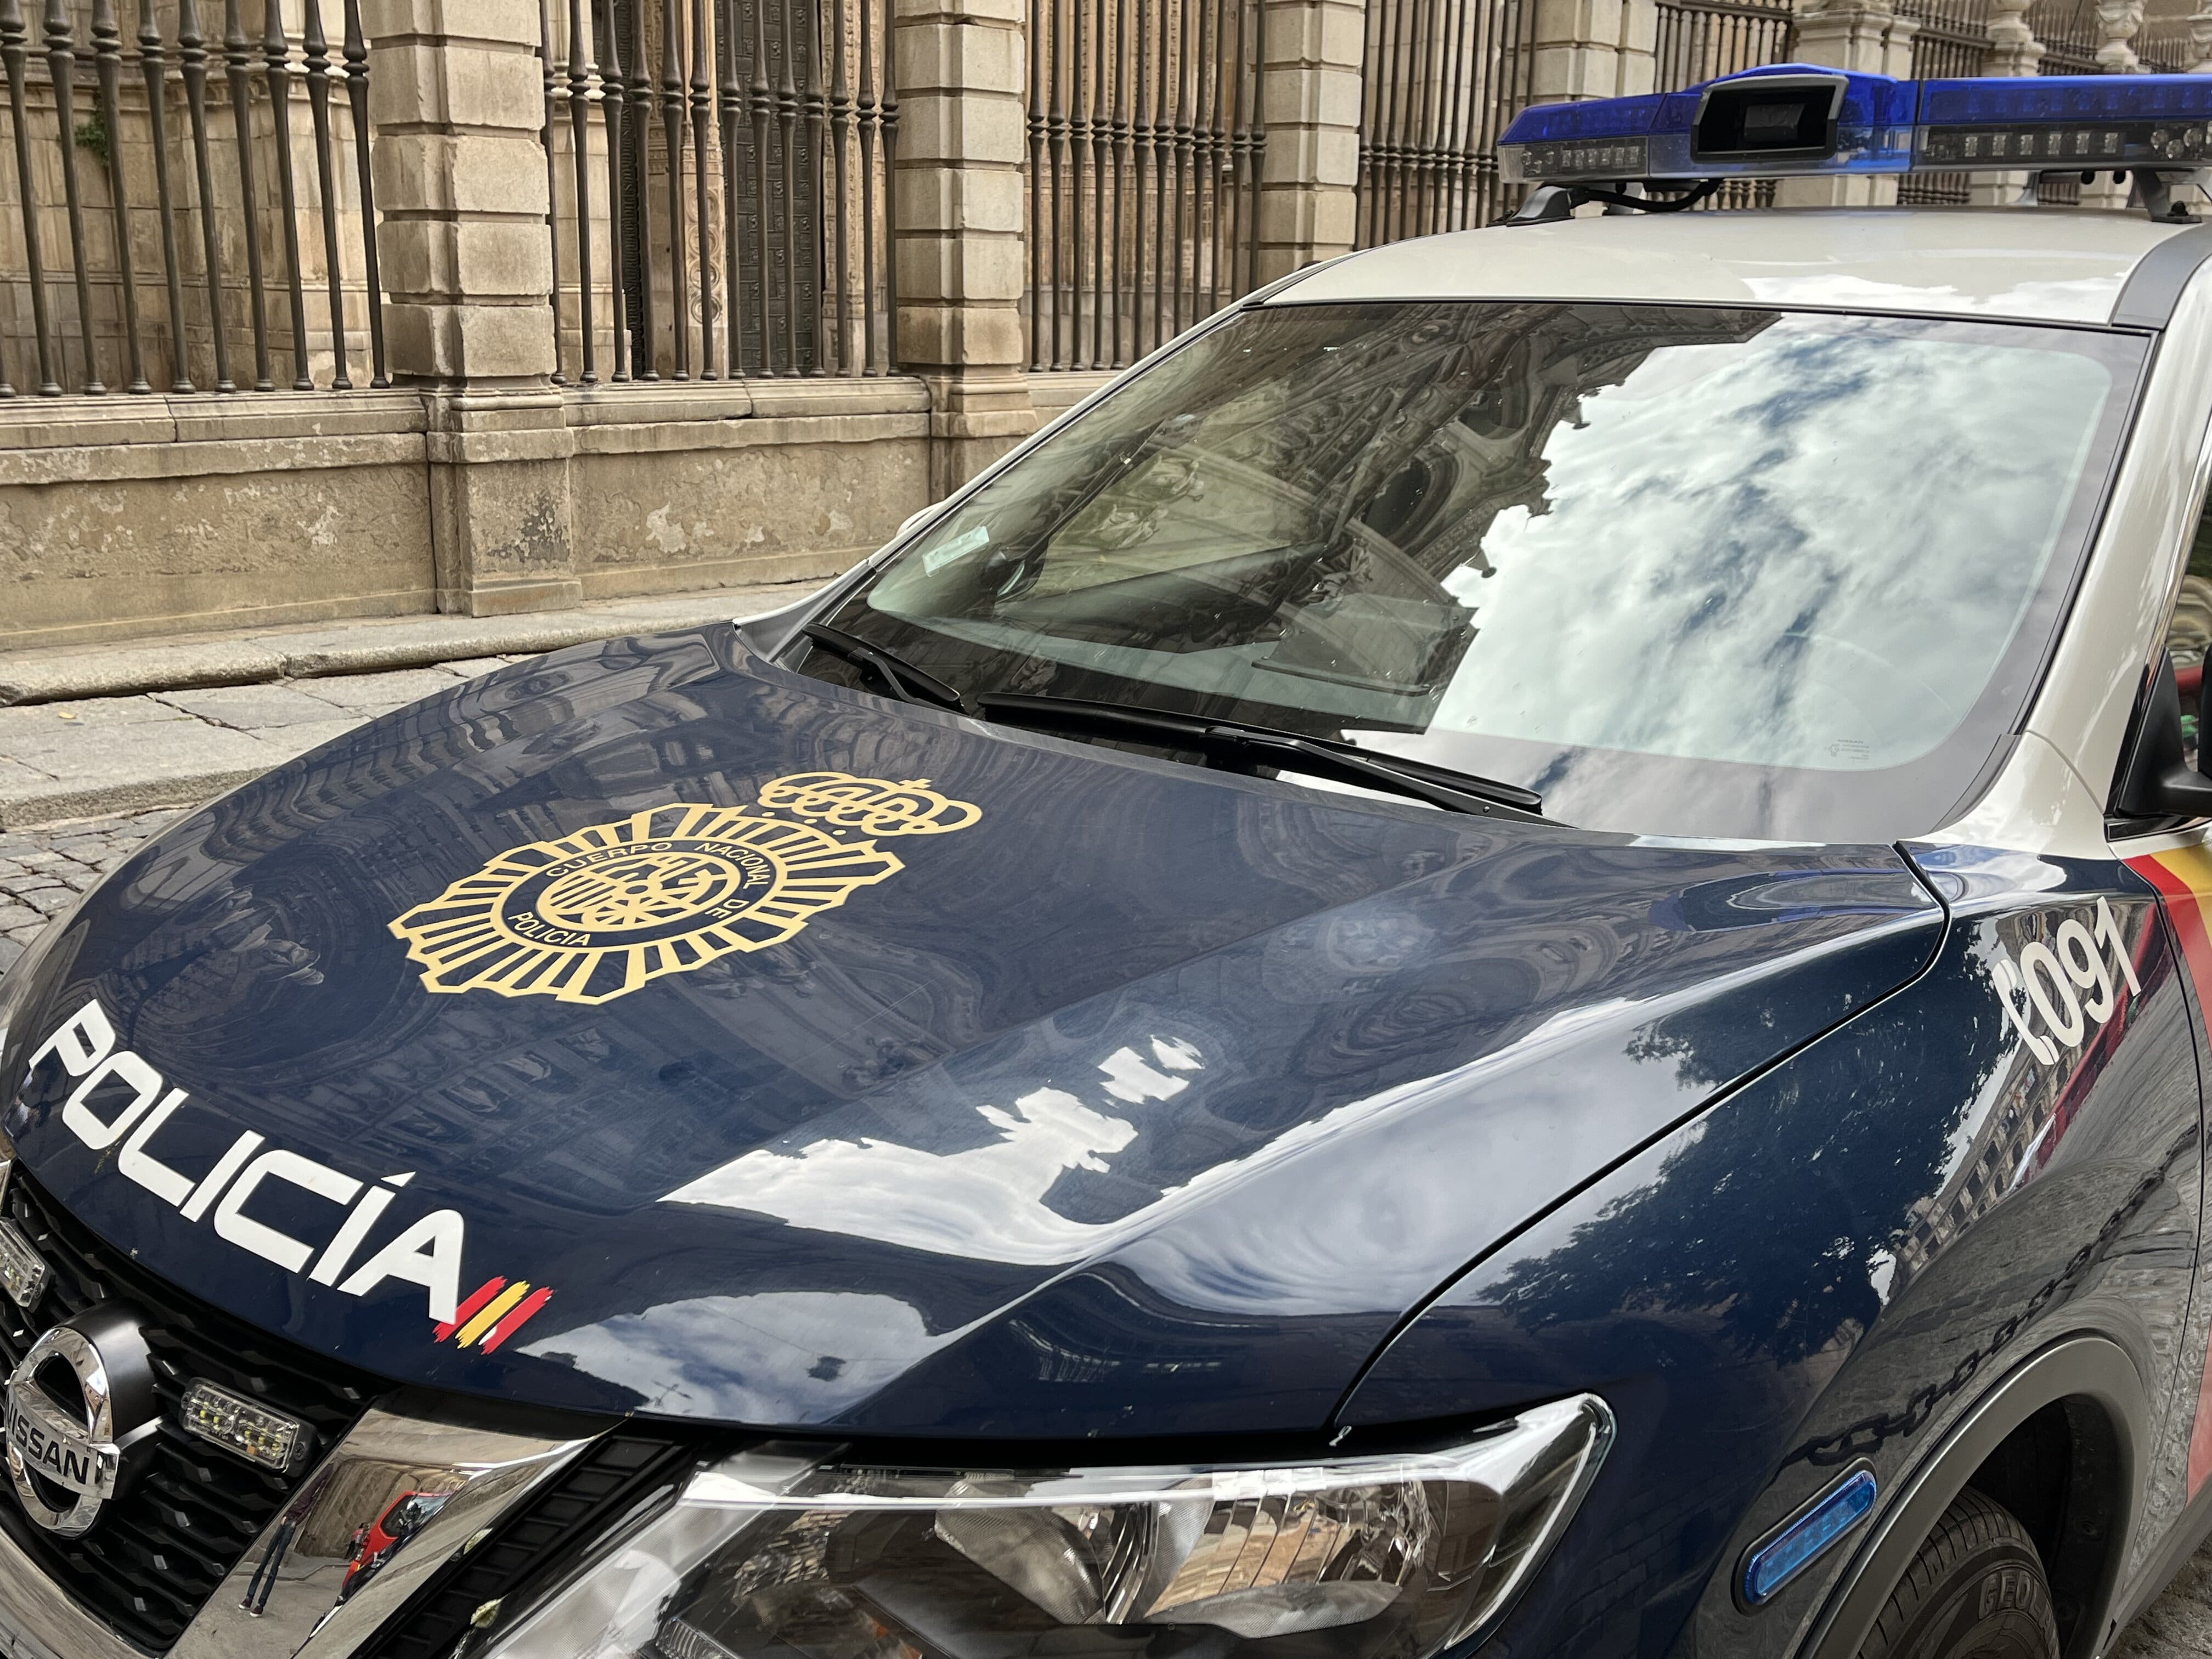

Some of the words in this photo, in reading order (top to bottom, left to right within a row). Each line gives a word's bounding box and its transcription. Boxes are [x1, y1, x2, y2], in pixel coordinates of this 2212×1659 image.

[546, 842, 673, 877] CUERPO
[696, 843, 771, 889] NACIONAL
[507, 911, 591, 946] POLICIA
[705, 899, 749, 919] DE
[2020, 896, 2141, 1047] 091
[29, 998, 464, 1324] POLICÍA
